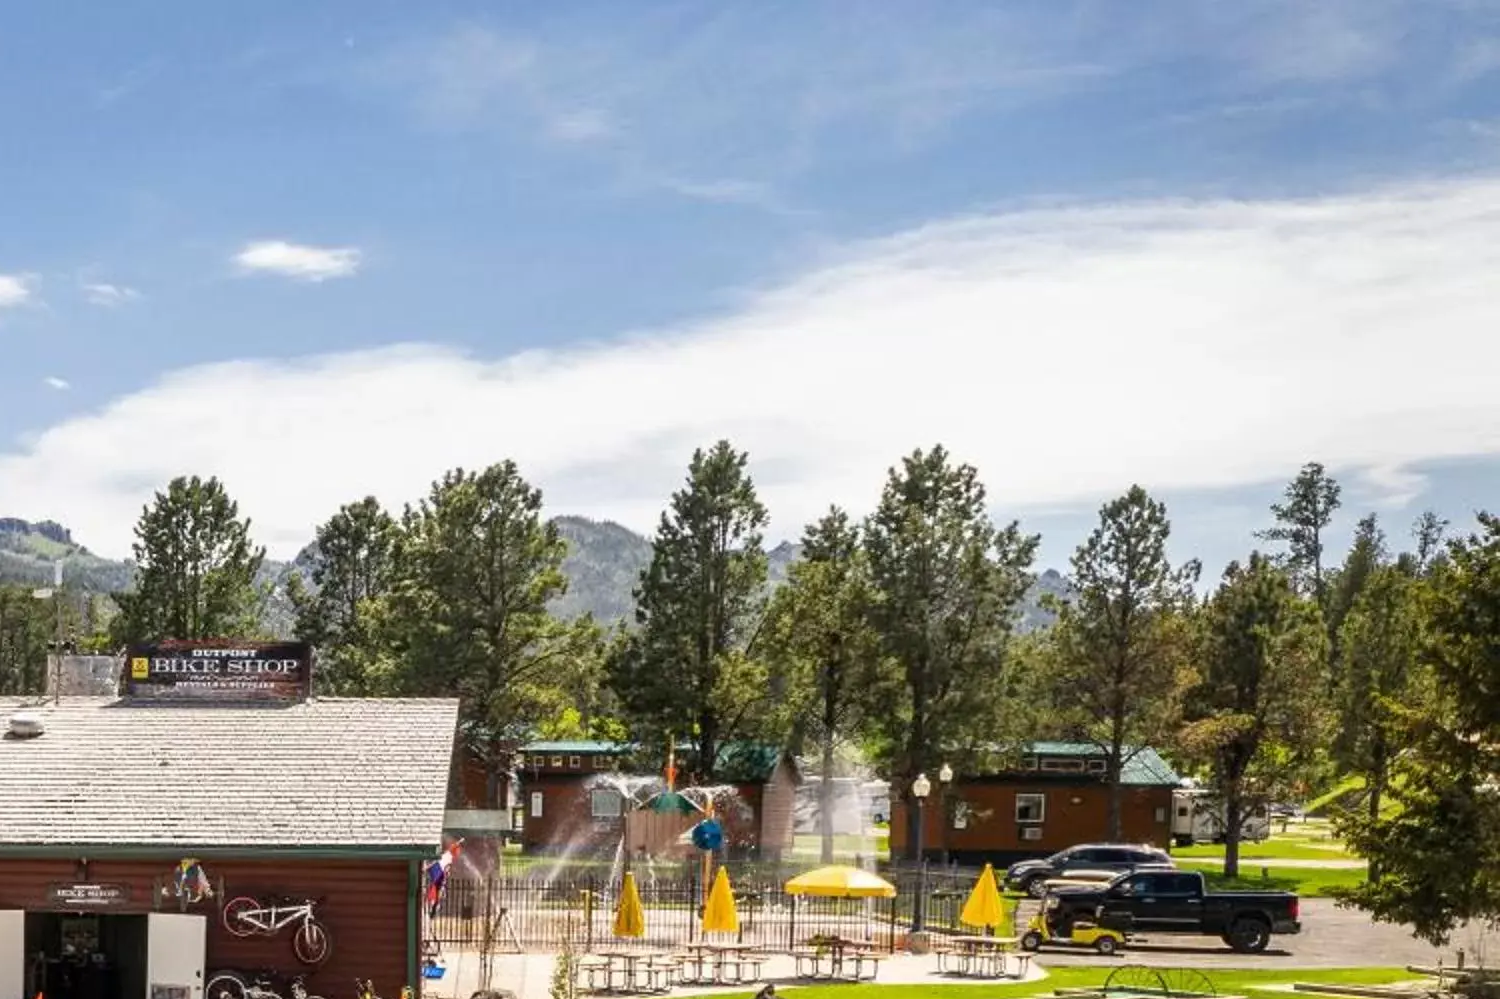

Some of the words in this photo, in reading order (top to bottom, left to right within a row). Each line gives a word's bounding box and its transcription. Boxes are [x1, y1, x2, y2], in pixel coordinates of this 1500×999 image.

[192, 649, 257, 657] OUTPOST
[154, 657, 220, 673] BIKE
[227, 659, 298, 674] SHOP
